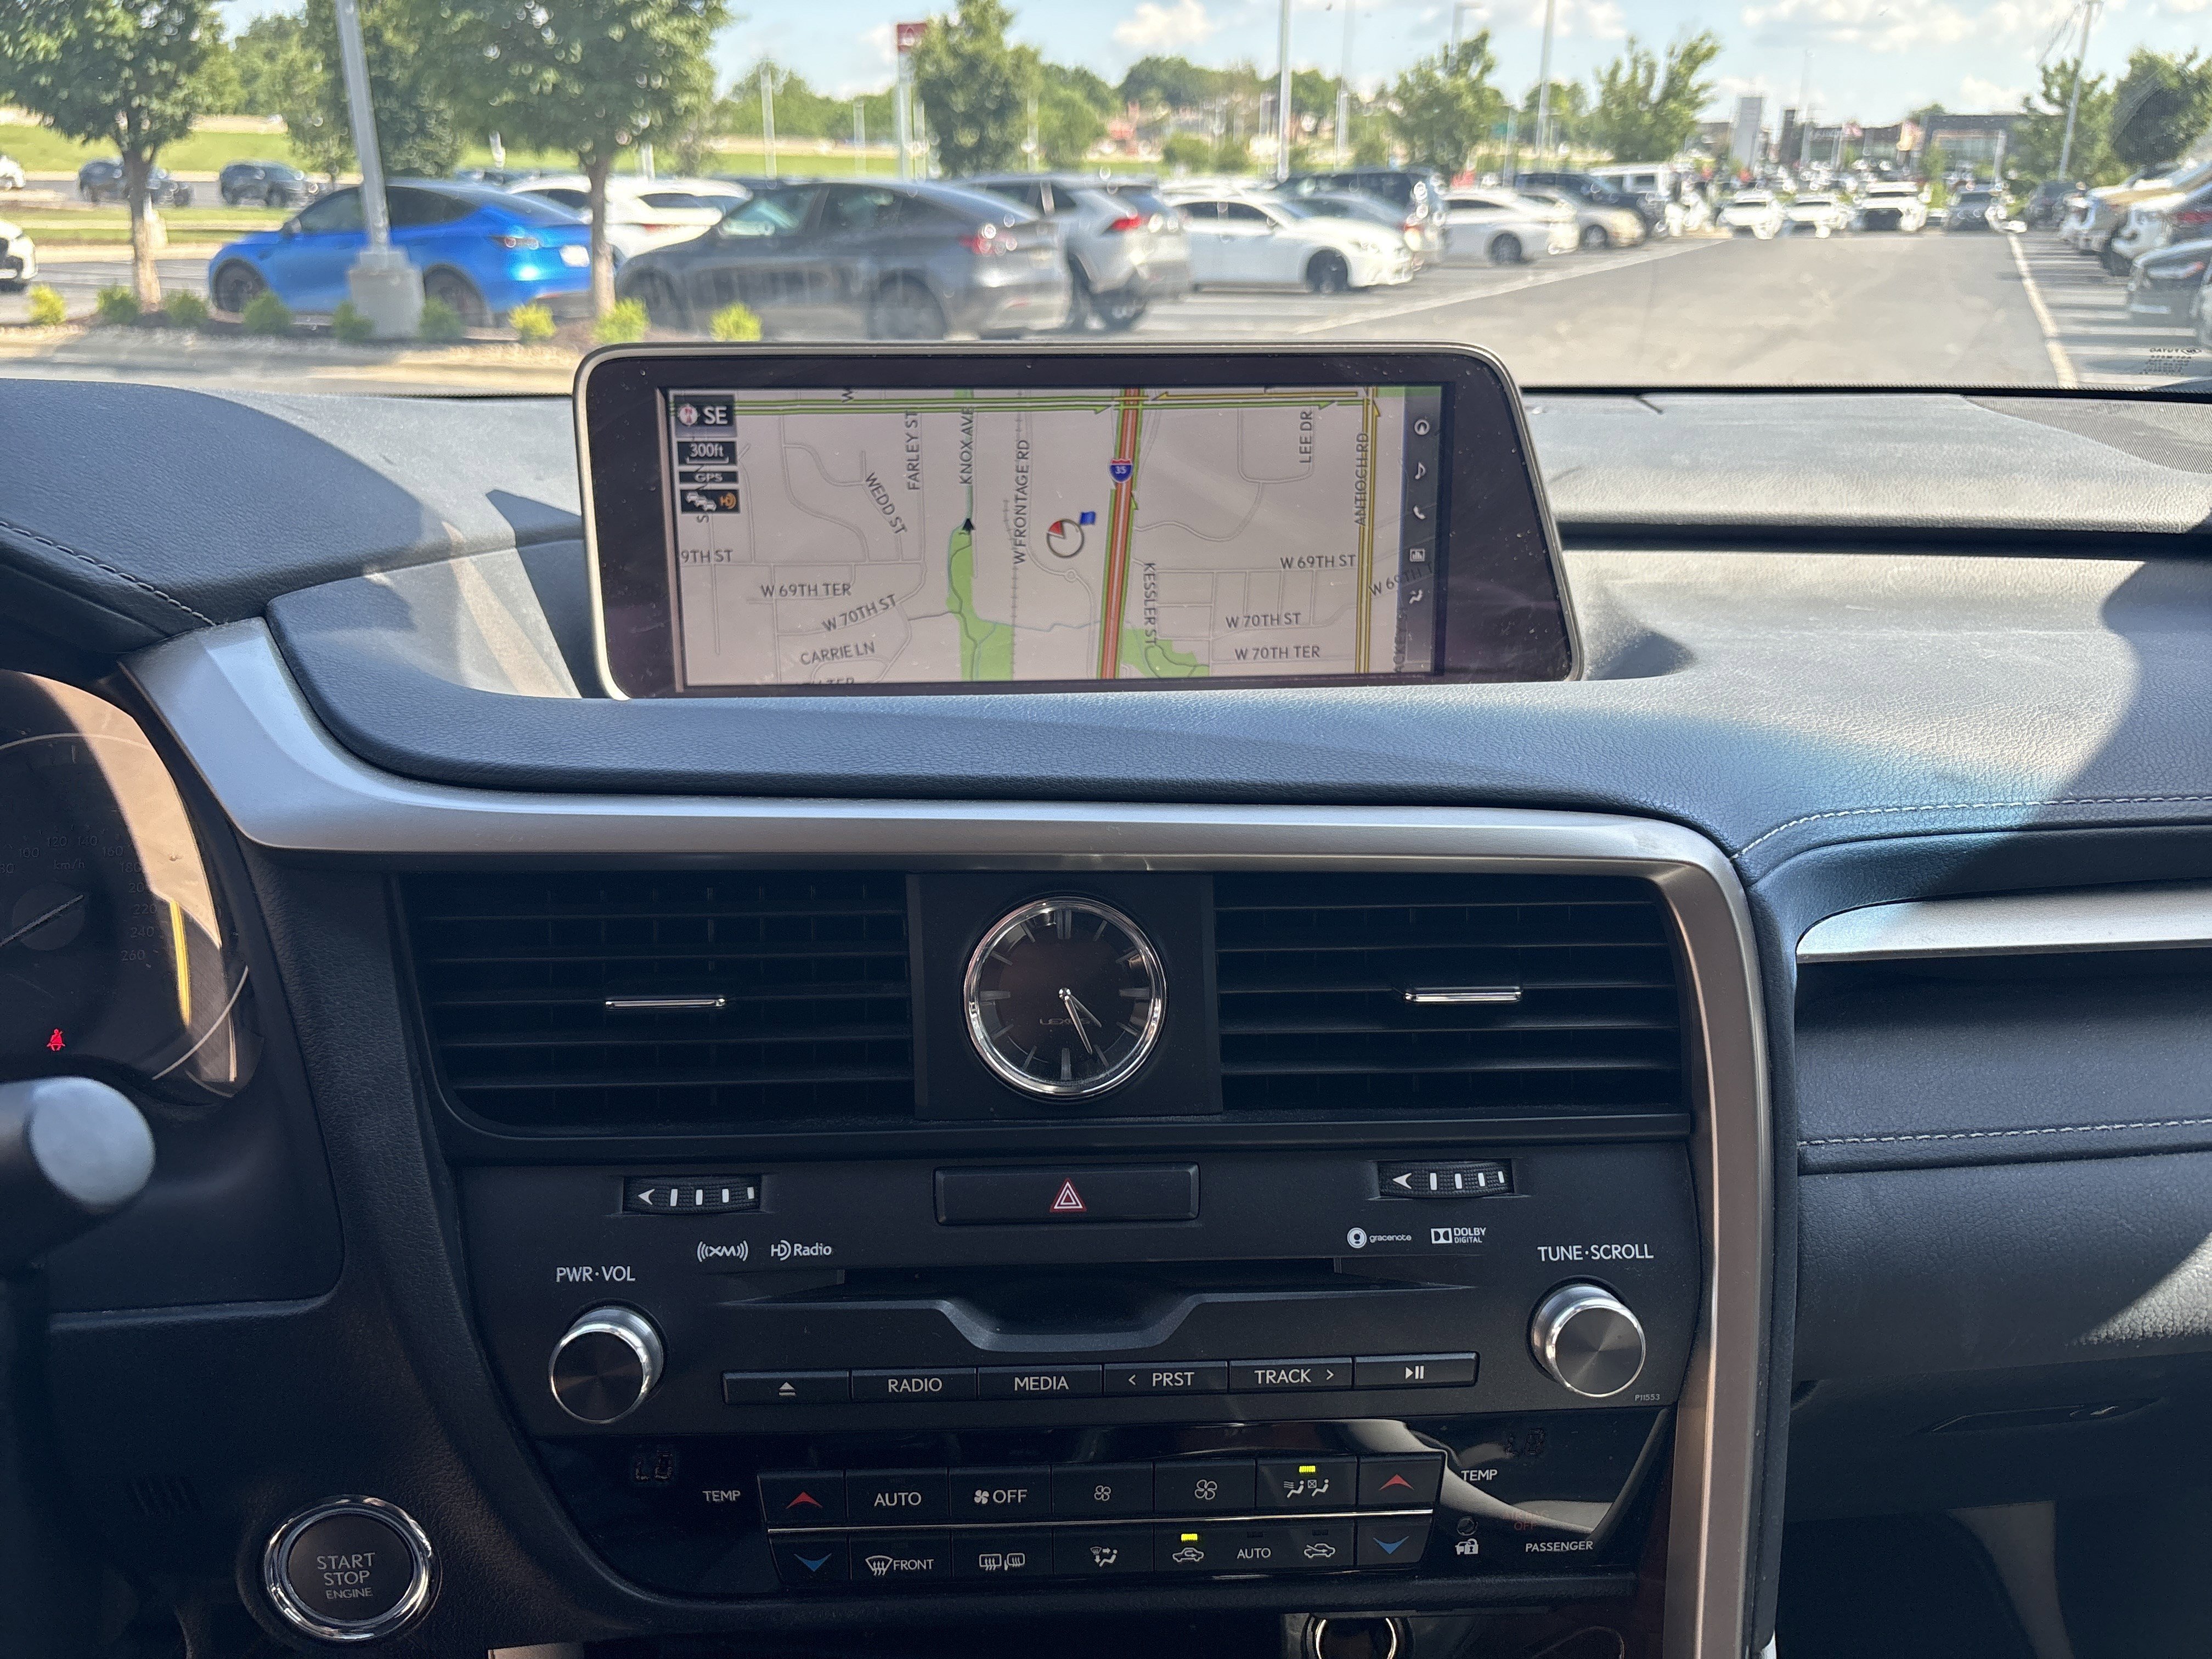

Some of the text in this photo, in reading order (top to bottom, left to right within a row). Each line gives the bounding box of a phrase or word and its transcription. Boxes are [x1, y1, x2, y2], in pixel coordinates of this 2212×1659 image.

[703, 405, 729, 425] SE
[1299, 410, 1313, 464] LEE DR
[690, 442, 724, 458] 300ft
[905, 410, 920, 492] FARLEY ST
[959, 407, 974, 484] KNOX AVE
[695, 472, 723, 482] GPS
[1115, 465, 1127, 475] 35
[1353, 432, 1369, 528] ANTIOCH RD
[865, 471, 908, 535] WEDD ST
[1013, 439, 1030, 565] W FRONTAGE RD
[681, 549, 733, 563] 9TH ST
[1280, 554, 1357, 569] W 69TH ST
[761, 583, 852, 597] W 69TH TER
[1369, 581, 1382, 596] W
[1143, 563, 1157, 645] KESSLER ST
[822, 594, 898, 633] W 70TH ST
[1226, 612, 1301, 628] W 70TH ST
[800, 641, 875, 665] CARRIE LN
[1234, 645, 1321, 661] W 70TH TER
[1369, 1234, 1412, 1244] gracenote
[1453, 1227, 1487, 1237] DOLBY
[793, 1242, 832, 1256] Radio
[1014, 1376, 1069, 1392] MEDIA
[1151, 1370, 1195, 1387] PRST
[1254, 1368, 1312, 1385] TRACK
[888, 1378, 943, 1393] RADIO
[1460, 1468, 1498, 1482] TEMP
[703, 1489, 741, 1503] TEMP
[874, 1491, 922, 1507] AUTO
[992, 1488, 1028, 1504] OFF
[1237, 1546, 1272, 1561] AUTO
[1525, 1539, 1594, 1553] PASSENGER
[317, 1552, 376, 1570] START
[893, 1558, 934, 1571] FRONT
[324, 1570, 370, 1586] STOP
[325, 1587, 374, 1600] ENGINE
